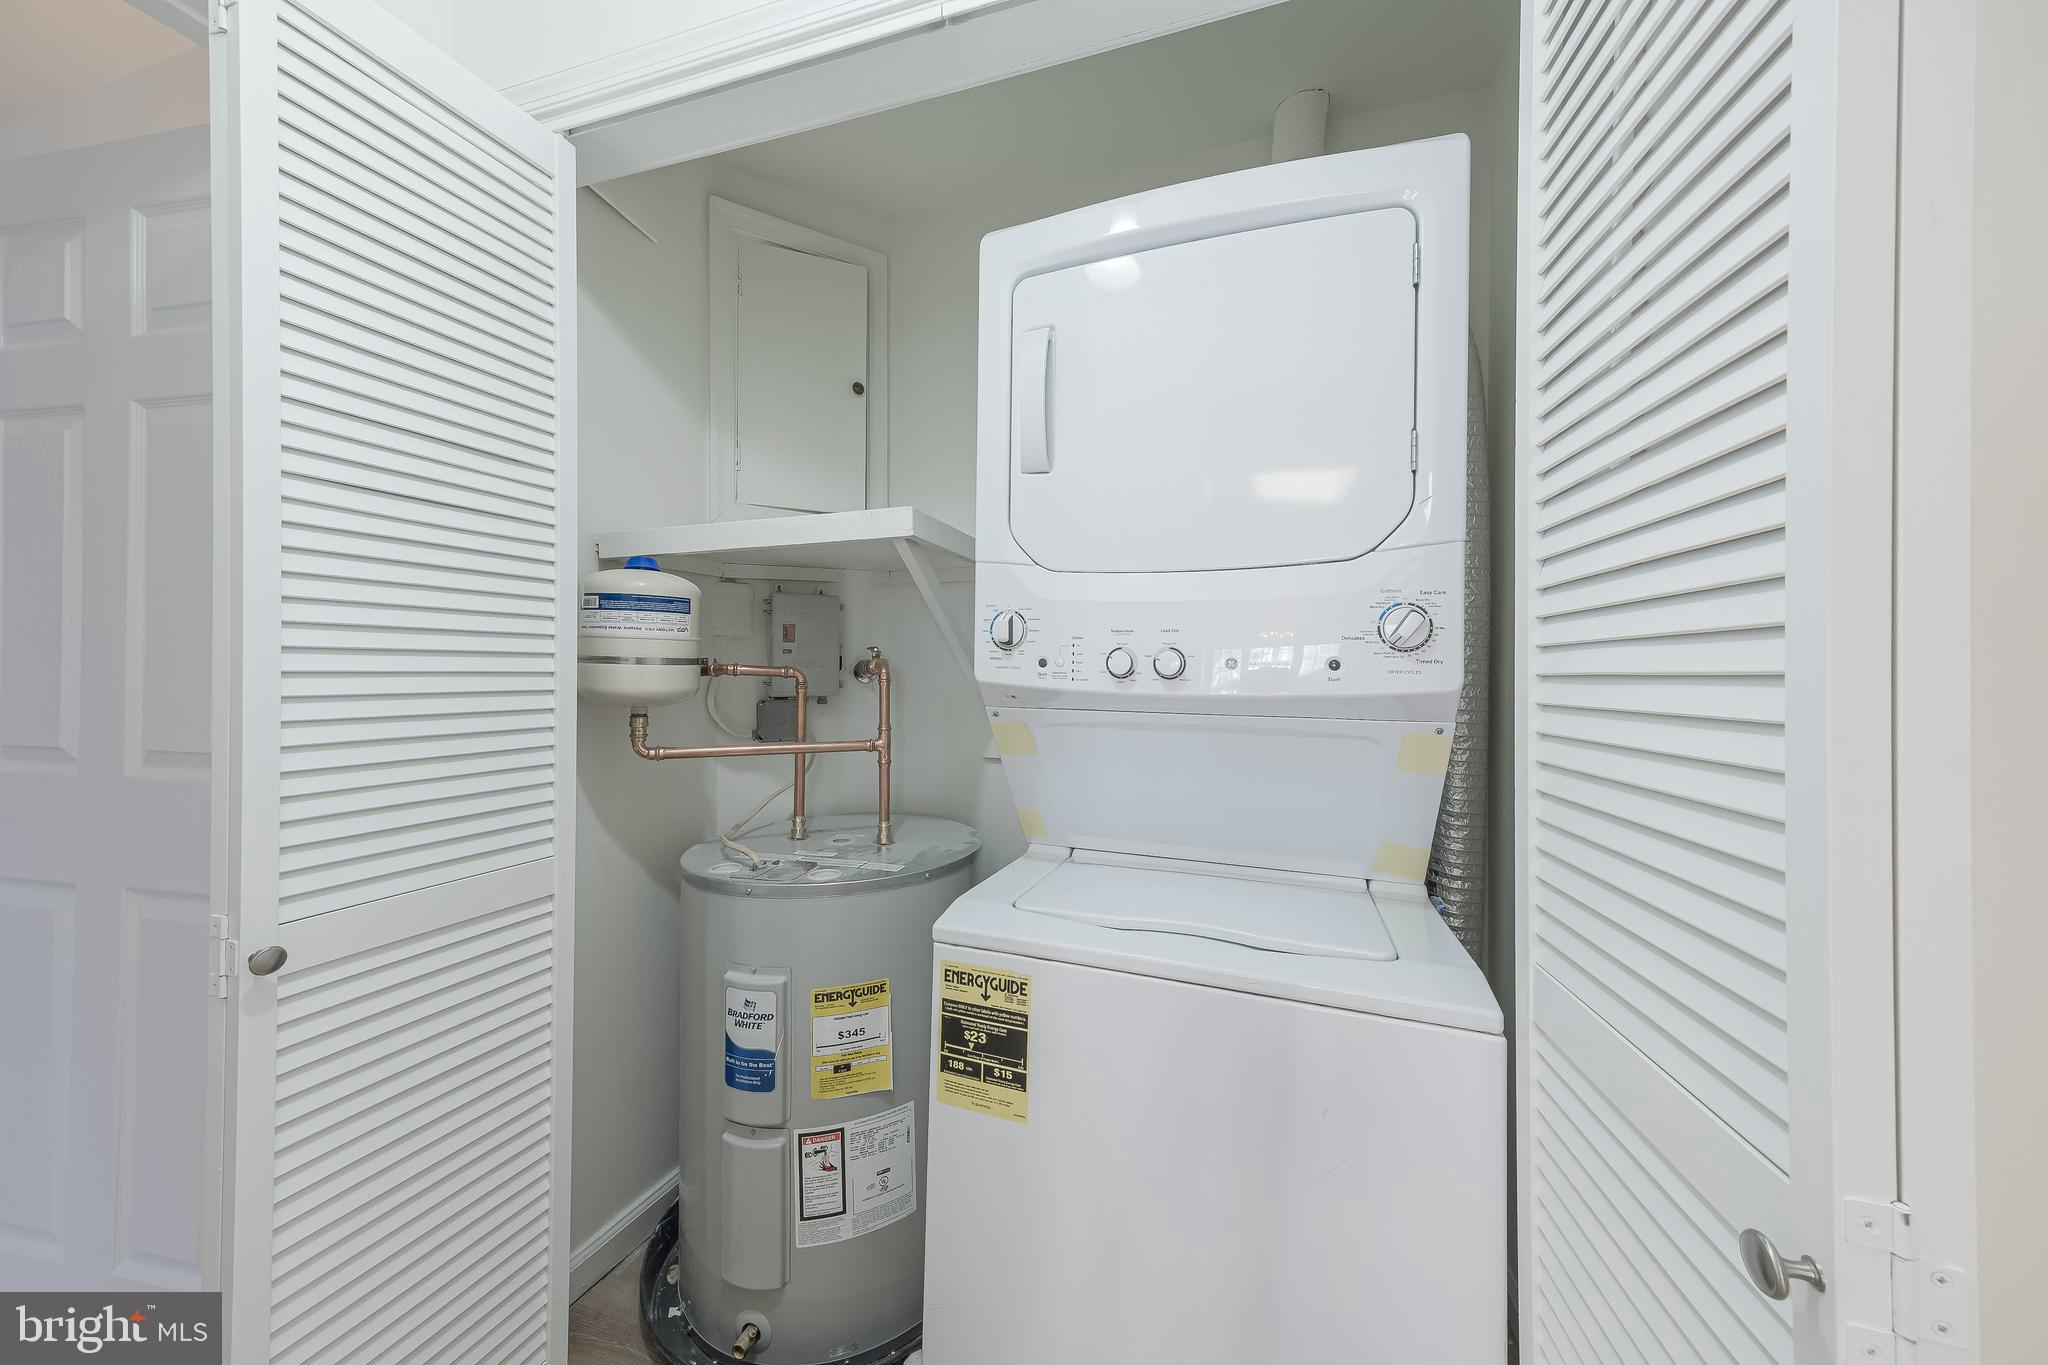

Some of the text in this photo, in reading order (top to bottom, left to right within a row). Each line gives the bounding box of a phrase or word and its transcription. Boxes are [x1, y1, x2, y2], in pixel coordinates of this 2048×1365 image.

[944, 968, 1028, 997] ENERGYGUIDE
[814, 982, 887, 1004] ENERGYGUIDE
[727, 1007, 774, 1021] BRADFORD
[734, 1018, 763, 1030] WHITE
[837, 1027, 866, 1040] $345
[963, 1030, 987, 1044] $23
[947, 1059, 965, 1071] 188
[993, 1068, 1013, 1080] $15
[812, 1134, 836, 1144] DANGER
